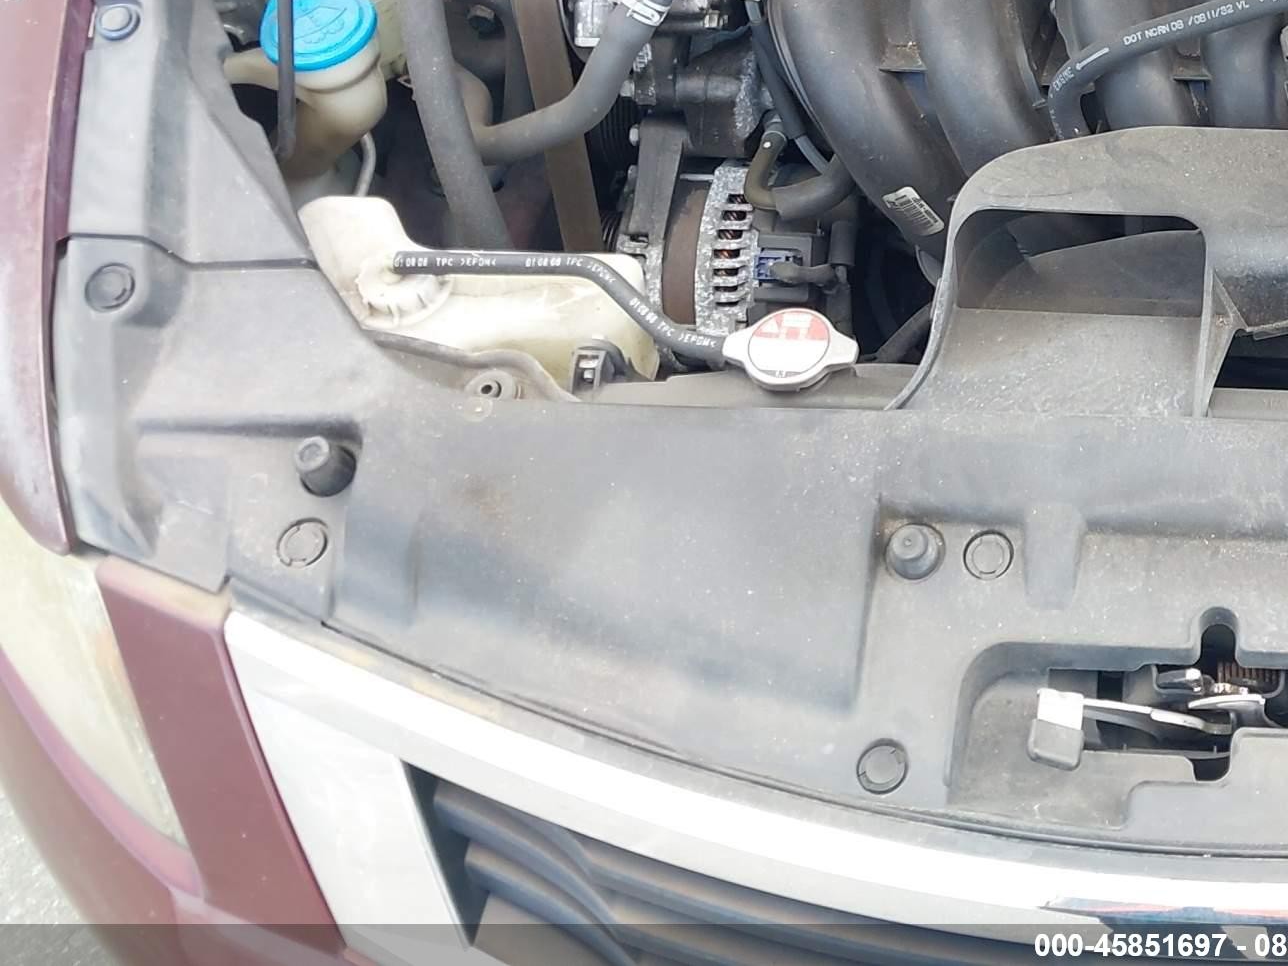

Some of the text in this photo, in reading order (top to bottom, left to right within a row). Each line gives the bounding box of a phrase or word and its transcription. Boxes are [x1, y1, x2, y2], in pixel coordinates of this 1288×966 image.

[1122, 32, 1143, 46] DOT
[1145, 23, 1170, 39] NCRN
[436, 257, 453, 267] TPC
[566, 257, 584, 267] TPC
[656, 320, 675, 337] TPC
